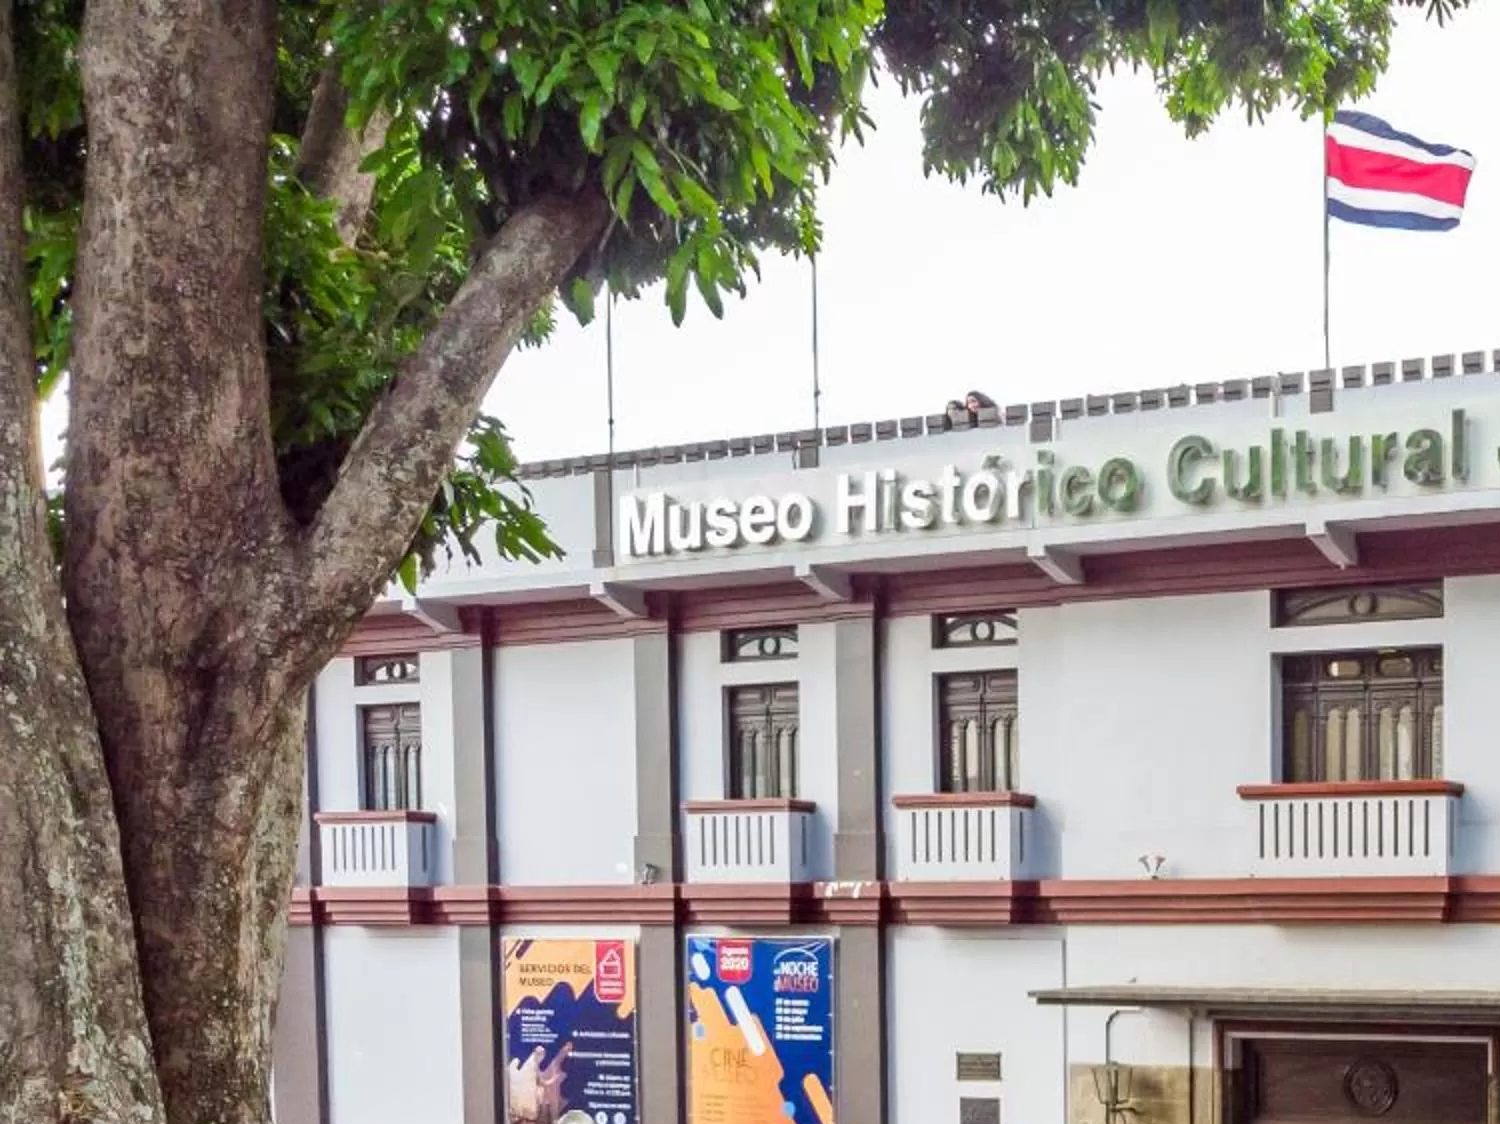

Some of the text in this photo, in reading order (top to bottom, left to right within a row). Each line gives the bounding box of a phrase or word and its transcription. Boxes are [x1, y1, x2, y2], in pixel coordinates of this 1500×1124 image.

[618, 490, 814, 556] Museo
[836, 451, 1144, 535] Histórico
[1167, 408, 1469, 506] Cultural
[519, 963, 571, 974] SERVICIOS
[780, 961, 818, 976] NOCHE
[519, 977, 554, 987] MUSEO
